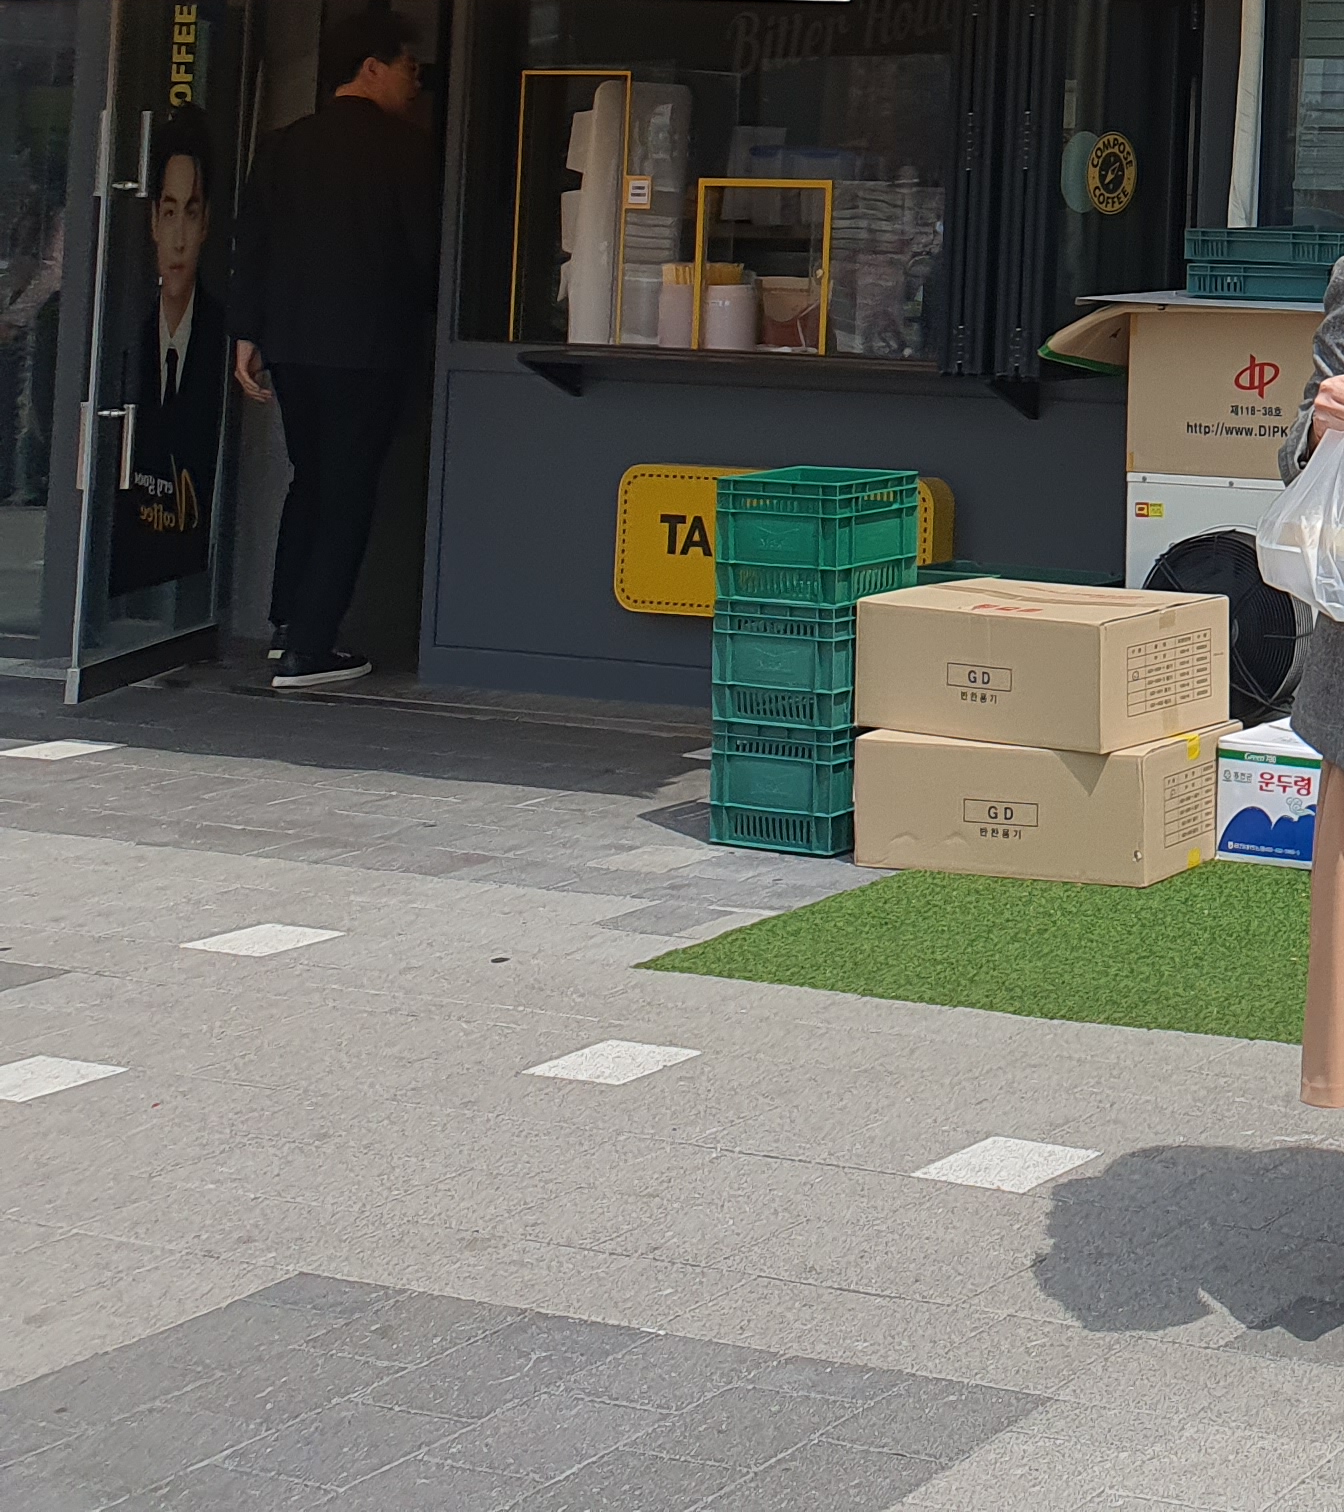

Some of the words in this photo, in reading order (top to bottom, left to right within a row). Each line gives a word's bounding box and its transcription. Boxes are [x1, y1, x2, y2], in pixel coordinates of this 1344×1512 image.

[169, 2, 198, 120] OFFEE
[1091, 137, 1133, 170] COMPOSE
[1093, 185, 1129, 208] COFFEE
[1258, 771, 1312, 797] 운두령
